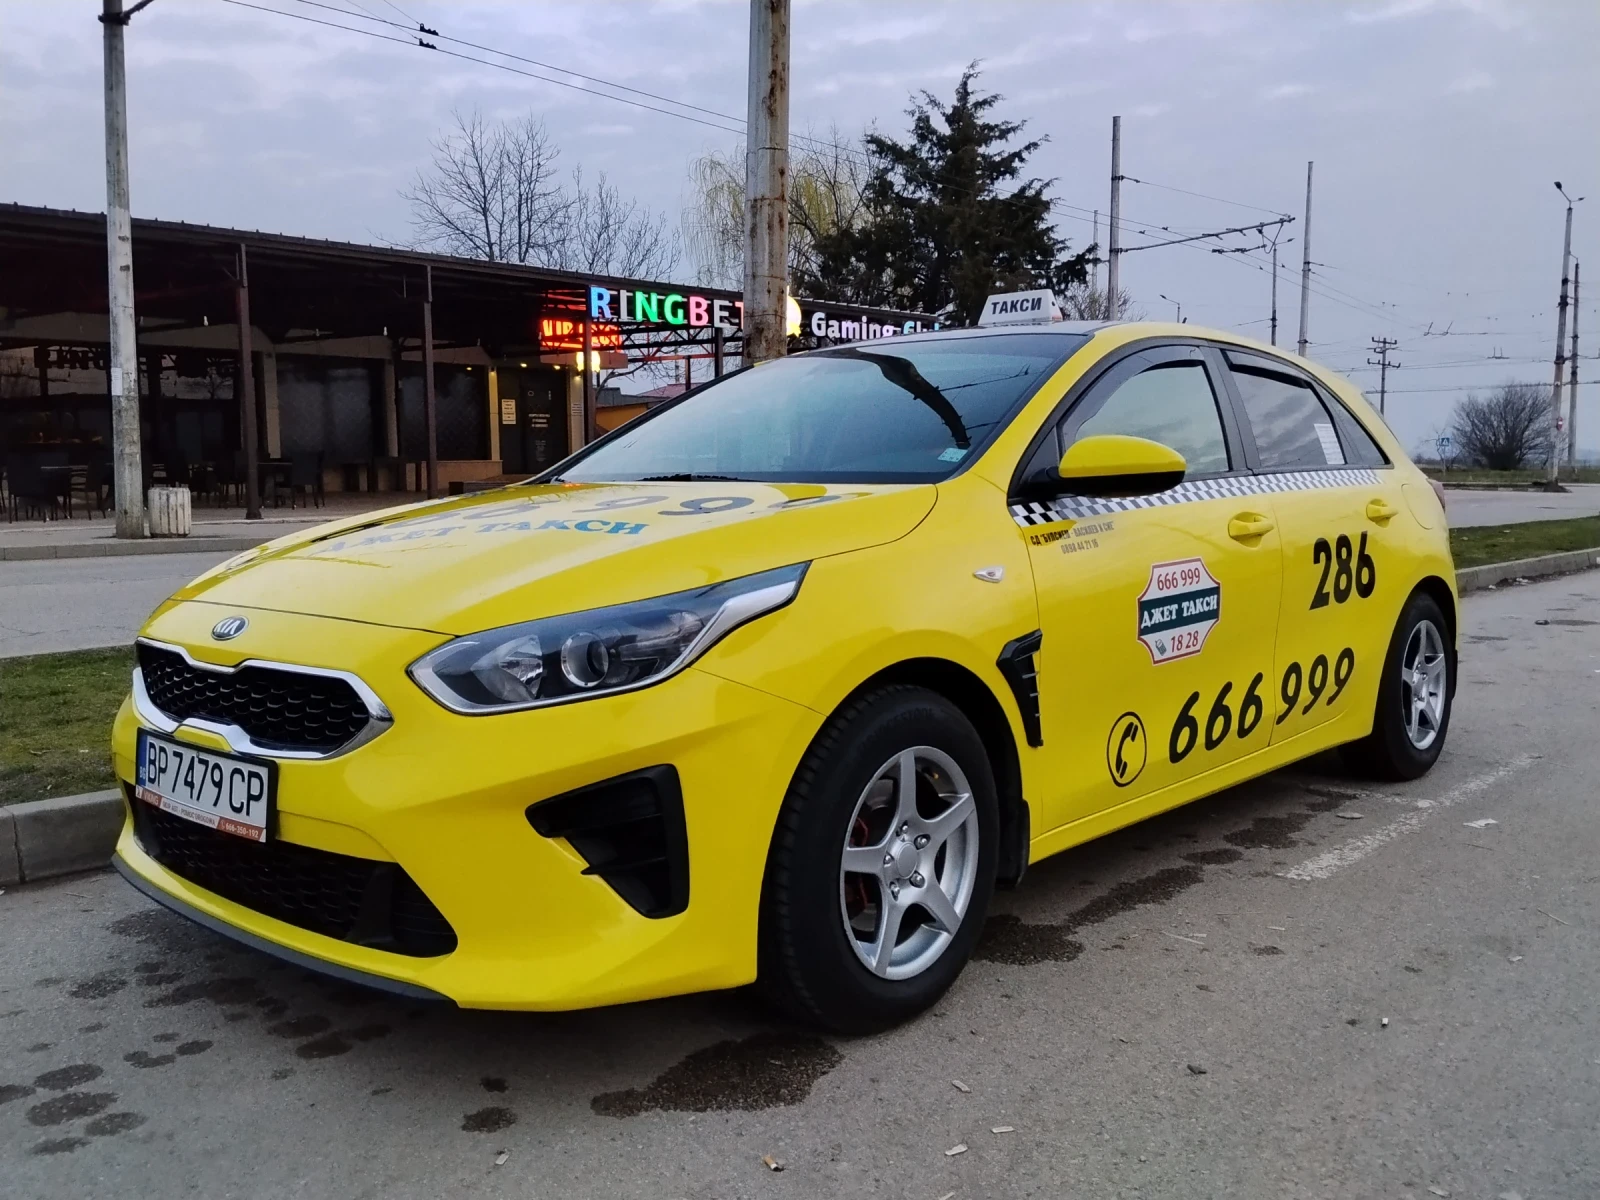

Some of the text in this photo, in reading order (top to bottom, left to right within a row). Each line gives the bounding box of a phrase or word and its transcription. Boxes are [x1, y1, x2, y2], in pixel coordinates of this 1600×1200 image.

[991, 297, 1042, 315] ТАКСИ
[811, 312, 894, 339] Gaming
[1157, 567, 1201, 591] 666 999
[1308, 530, 1376, 610] 286
[1140, 594, 1218, 629] ДЖЕТ ТАКСИ
[213, 618, 242, 635] KIA
[1170, 630, 1199, 653] 18 28
[1169, 647, 1355, 764] 666 999
[147, 741, 264, 816] BP 7479 CP
